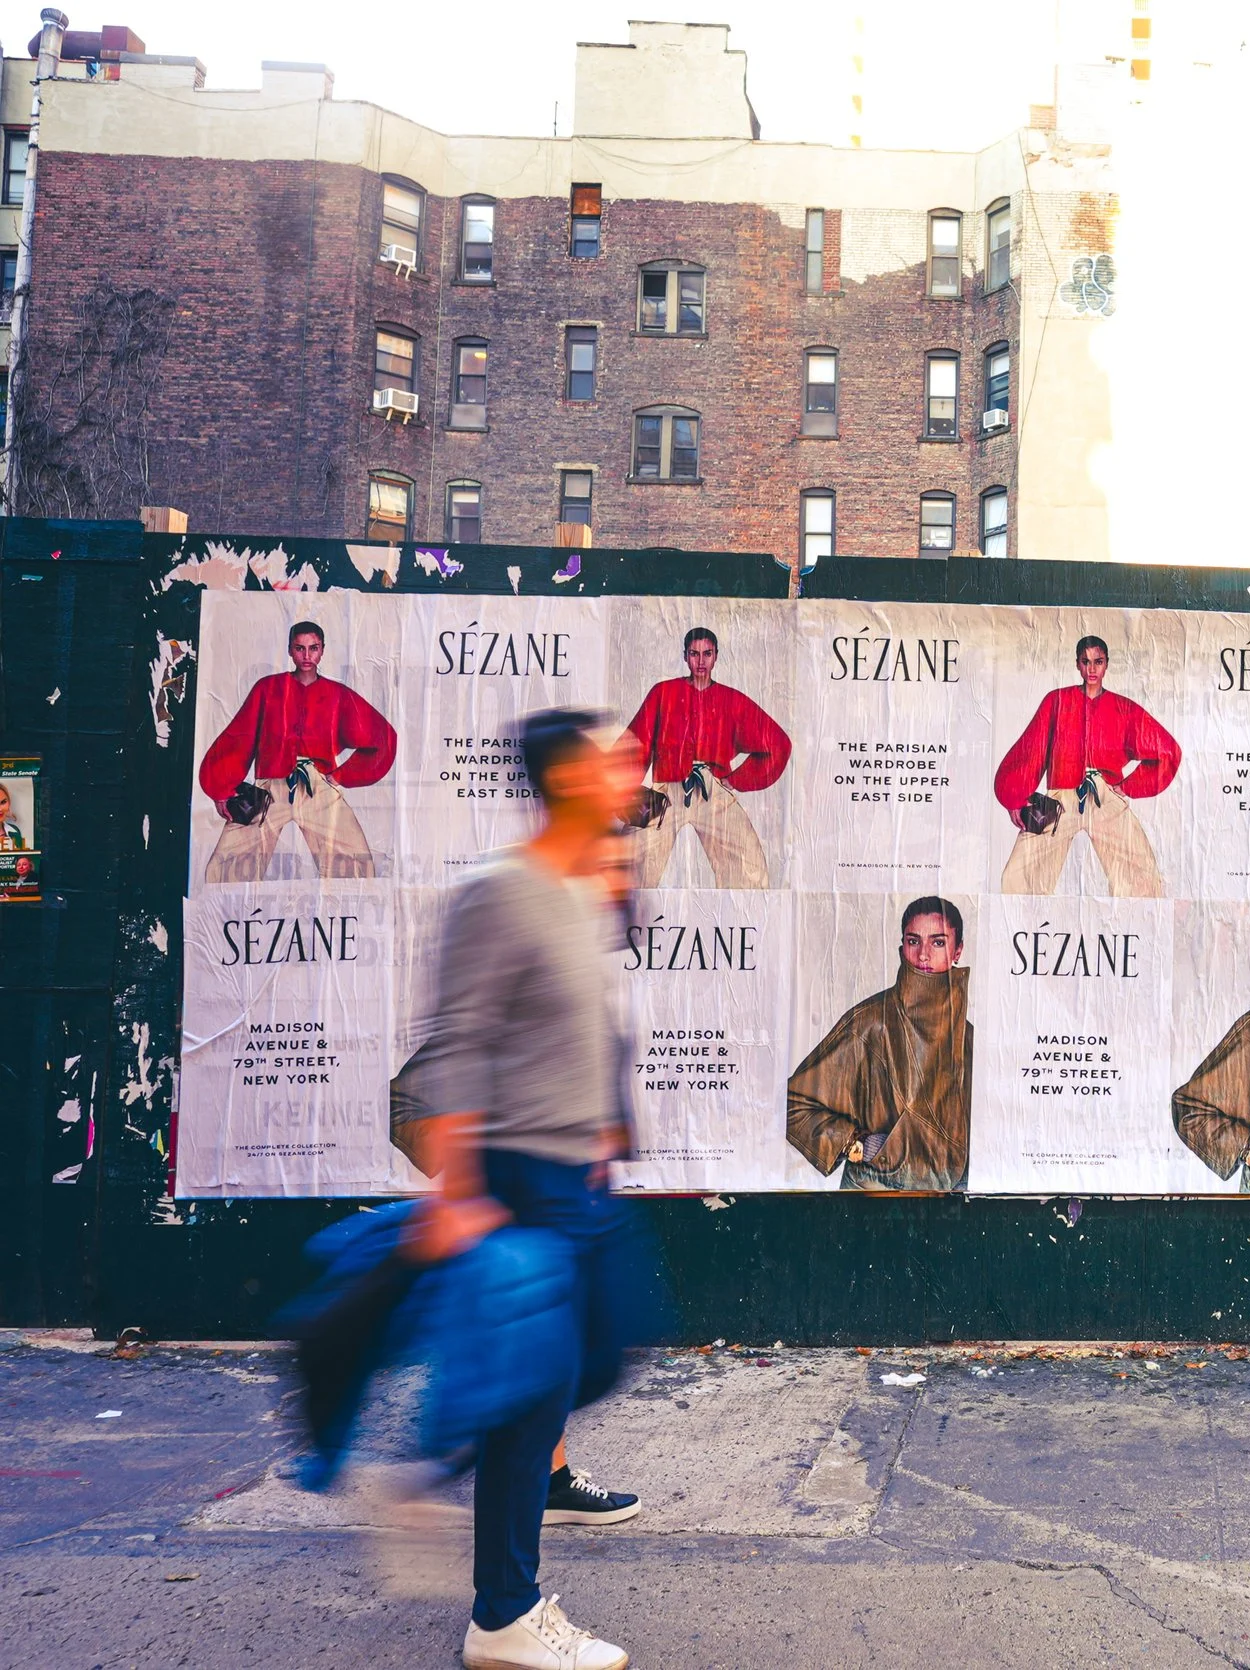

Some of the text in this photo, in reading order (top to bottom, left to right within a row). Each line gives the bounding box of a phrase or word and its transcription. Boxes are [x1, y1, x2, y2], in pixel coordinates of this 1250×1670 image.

[436, 621, 570, 677] SÉZANE
[831, 627, 959, 682] SÉZANE
[444, 738, 527, 748] THE PARIS
[838, 743, 947, 753] THE PARISIAN
[455, 755, 523, 765] WARDRO
[850, 759, 936, 769] WARDROBE
[440, 772, 460, 780] ON
[469, 772, 499, 781] THE
[834, 776, 949, 786] ON THE UPPER
[458, 789, 540, 798] EAST SIDE
[1223, 785, 1242, 794] ON
[852, 792, 932, 802] EAST SIDE
[221, 908, 358, 966] SÉZANE
[624, 914, 757, 970] SÉZANE
[1011, 921, 1139, 977] SÉZANE
[250, 1023, 323, 1033] MADISON
[653, 1030, 724, 1039] MADISON
[245, 1040, 309, 1051] AVENUE
[317, 1039, 327, 1049] &
[1038, 1036, 1107, 1045] MADISON
[648, 1047, 728, 1056] AVENUE &
[233, 1056, 340, 1068] 79TH STREET,
[1033, 1052, 1111, 1062] AVENUE &
[635, 1064, 739, 1074] 79TH STREET,
[1022, 1068, 1121, 1080] 79TH STREET,
[244, 1074, 329, 1085] NEW YORK
[646, 1081, 729, 1090] NEW YORK
[1031, 1086, 1111, 1095] NEW YORK
